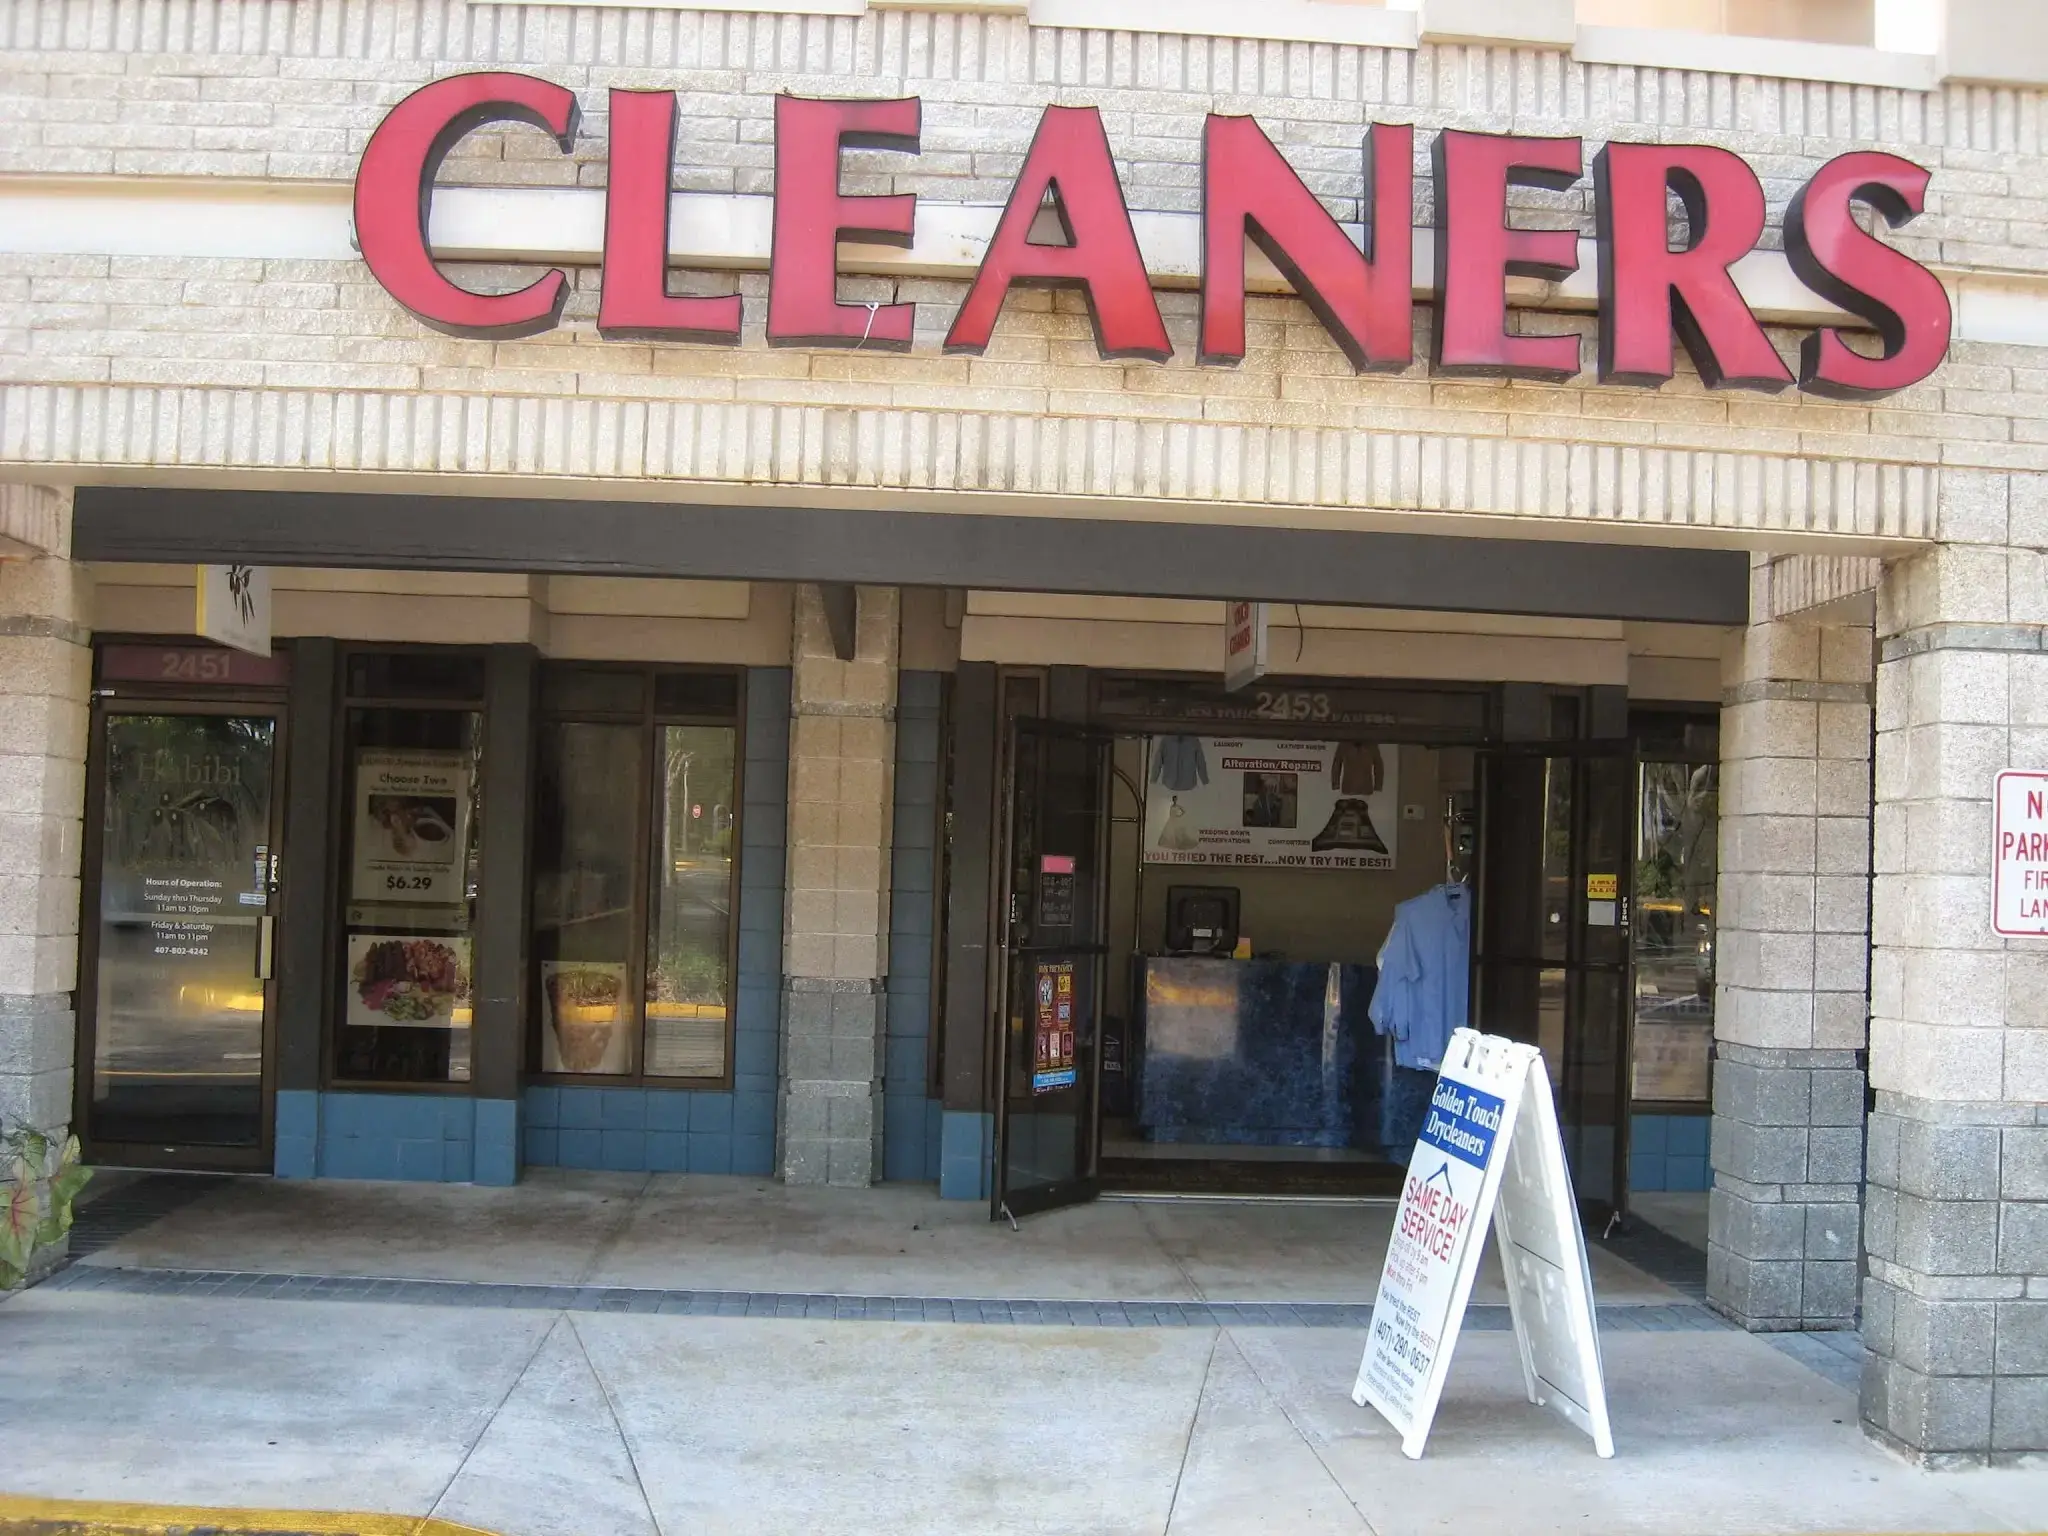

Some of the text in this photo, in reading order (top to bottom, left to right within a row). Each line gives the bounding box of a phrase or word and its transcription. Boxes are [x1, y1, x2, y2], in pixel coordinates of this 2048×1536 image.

[353, 71, 1951, 399] CLEANERS
[162, 652, 230, 679] 2451
[1256, 691, 1330, 720] 2453
[1223, 759, 1321, 771] Alteration/Repairs
[379, 772, 447, 786] Choose Two
[2028, 790, 2048, 820] N
[1144, 851, 1169, 861] YOU
[1171, 852, 1207, 863] TRIED
[1209, 853, 1232, 863] THE
[1309, 856, 1332, 866] TRY
[1333, 857, 1357, 867] THE
[1359, 858, 1392, 868] BEST!
[146, 878, 222, 889] Hours of Operation:
[386, 875, 432, 890] $6.29
[144, 893, 222, 904] Sunday thru Thursday
[157, 904, 177, 912] 11am
[188, 905, 209, 915] 10pm
[151, 921, 214, 932] Friday & Saturday
[157, 932, 209, 942] 11am to 11pm
[1432, 1082, 1501, 1131] Golden Touch
[1426, 1110, 1487, 1157] Drycleaners
[1406, 1176, 1468, 1235] SAME DAY
[1401, 1206, 1456, 1265] SERVICE!
[1406, 1305, 1420, 1324] REST
